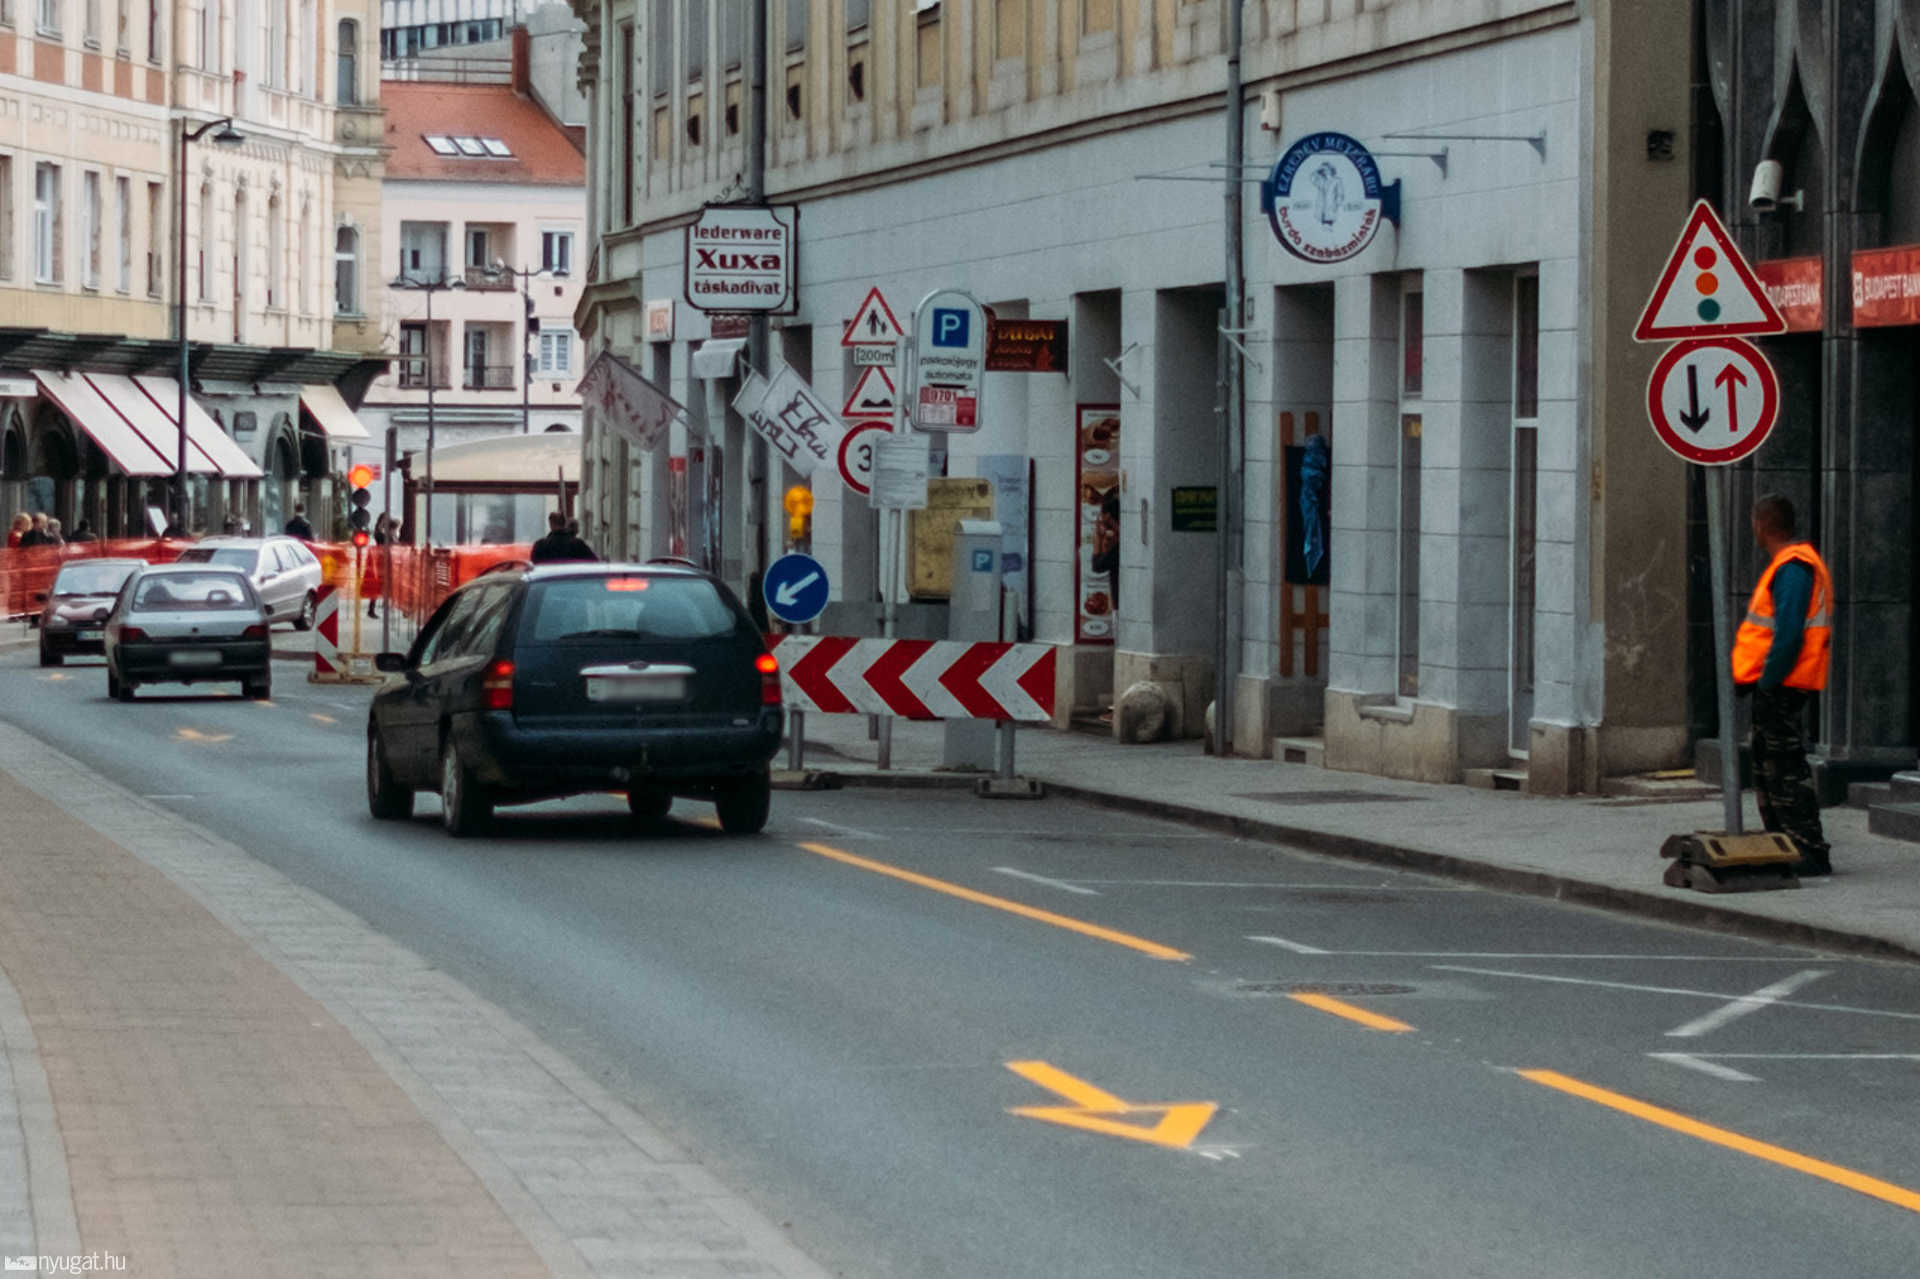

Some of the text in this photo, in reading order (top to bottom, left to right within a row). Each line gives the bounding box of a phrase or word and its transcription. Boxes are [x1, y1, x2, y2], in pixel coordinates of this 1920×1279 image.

[694, 223, 782, 240] lederware
[696, 247, 781, 270] Xuxa
[694, 280, 781, 295] táskadivat
[1865, 275, 1901, 300] BUDAPEST
[941, 313, 961, 342] P
[857, 444, 873, 472] 3
